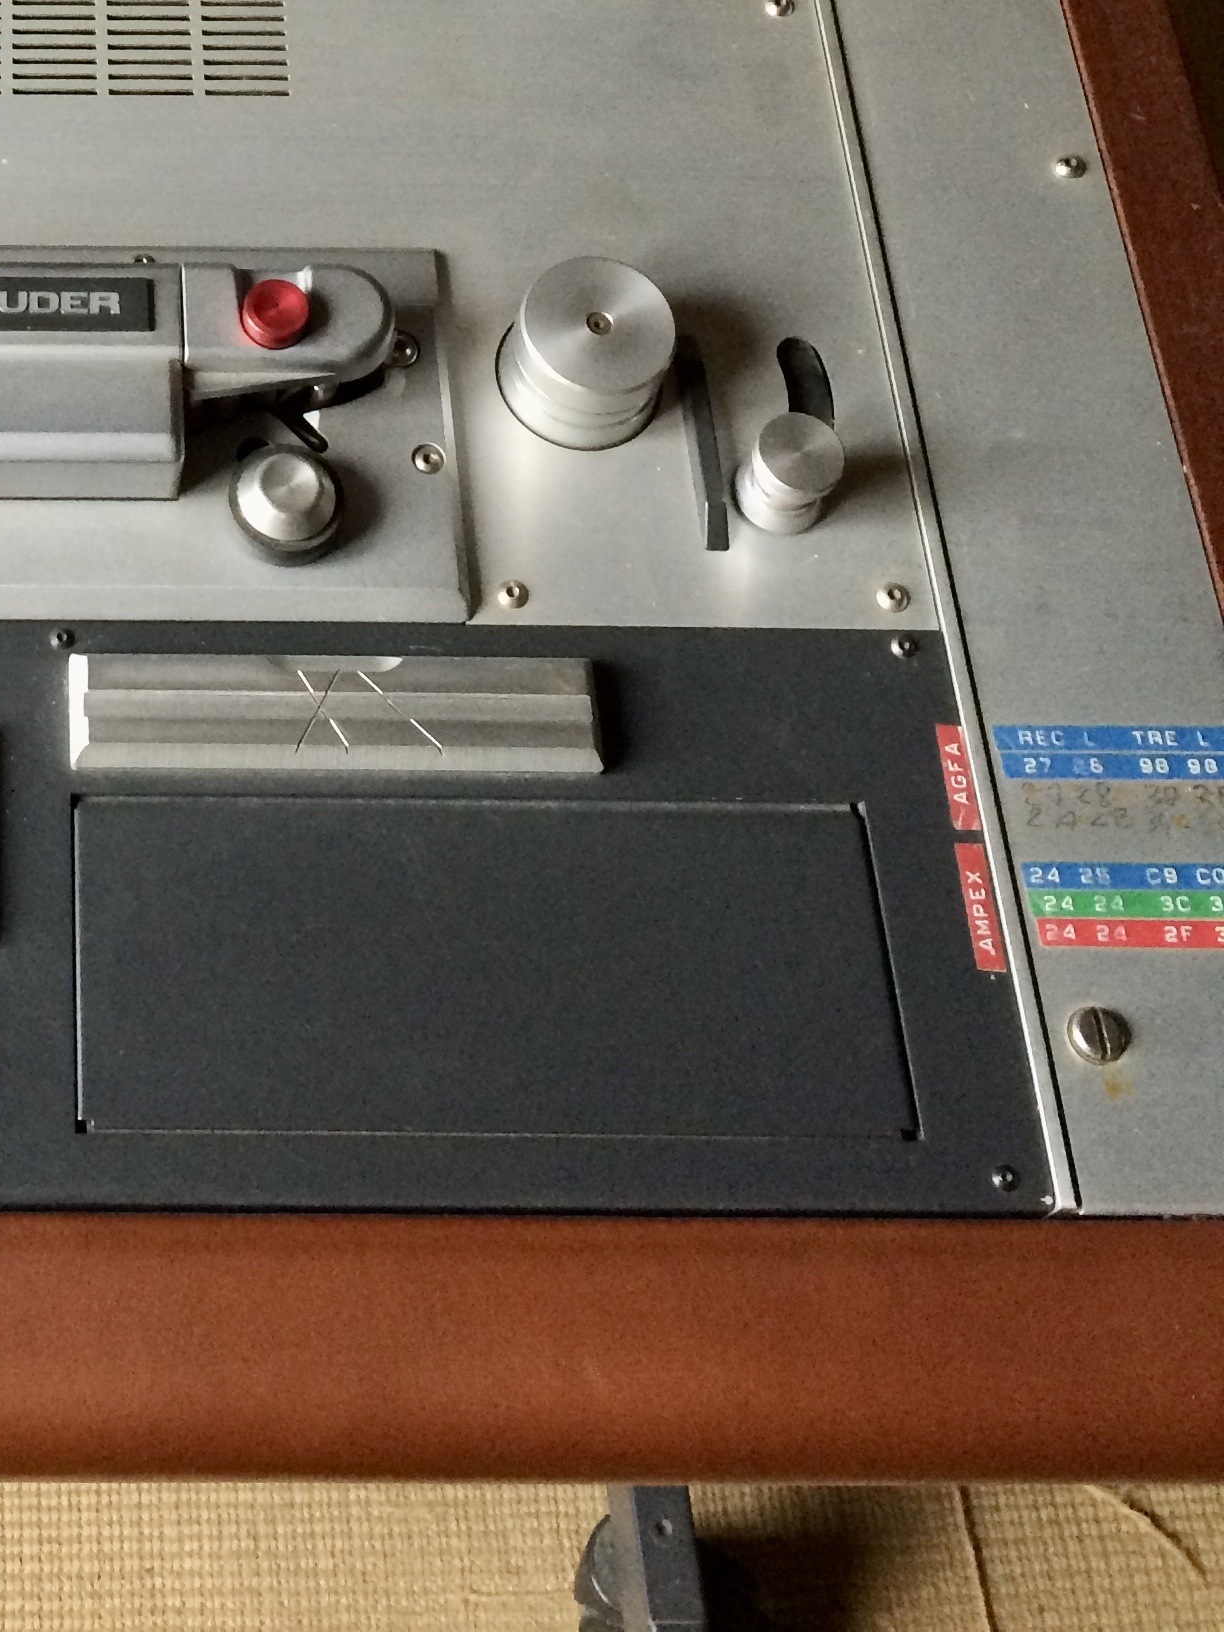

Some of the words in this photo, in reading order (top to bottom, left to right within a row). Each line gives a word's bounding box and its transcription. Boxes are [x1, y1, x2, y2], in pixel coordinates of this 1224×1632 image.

[1018, 730, 1065, 747] REC
[1196, 731, 1210, 747] L
[945, 742, 969, 805] AGFA
[1023, 757, 1051, 774] 27
[1029, 866, 1061, 884] 24
[1043, 895, 1074, 911] 24
[1160, 895, 1192, 912] 3C
[966, 870, 996, 956] AMPEX
[1045, 923, 1076, 941] 24
